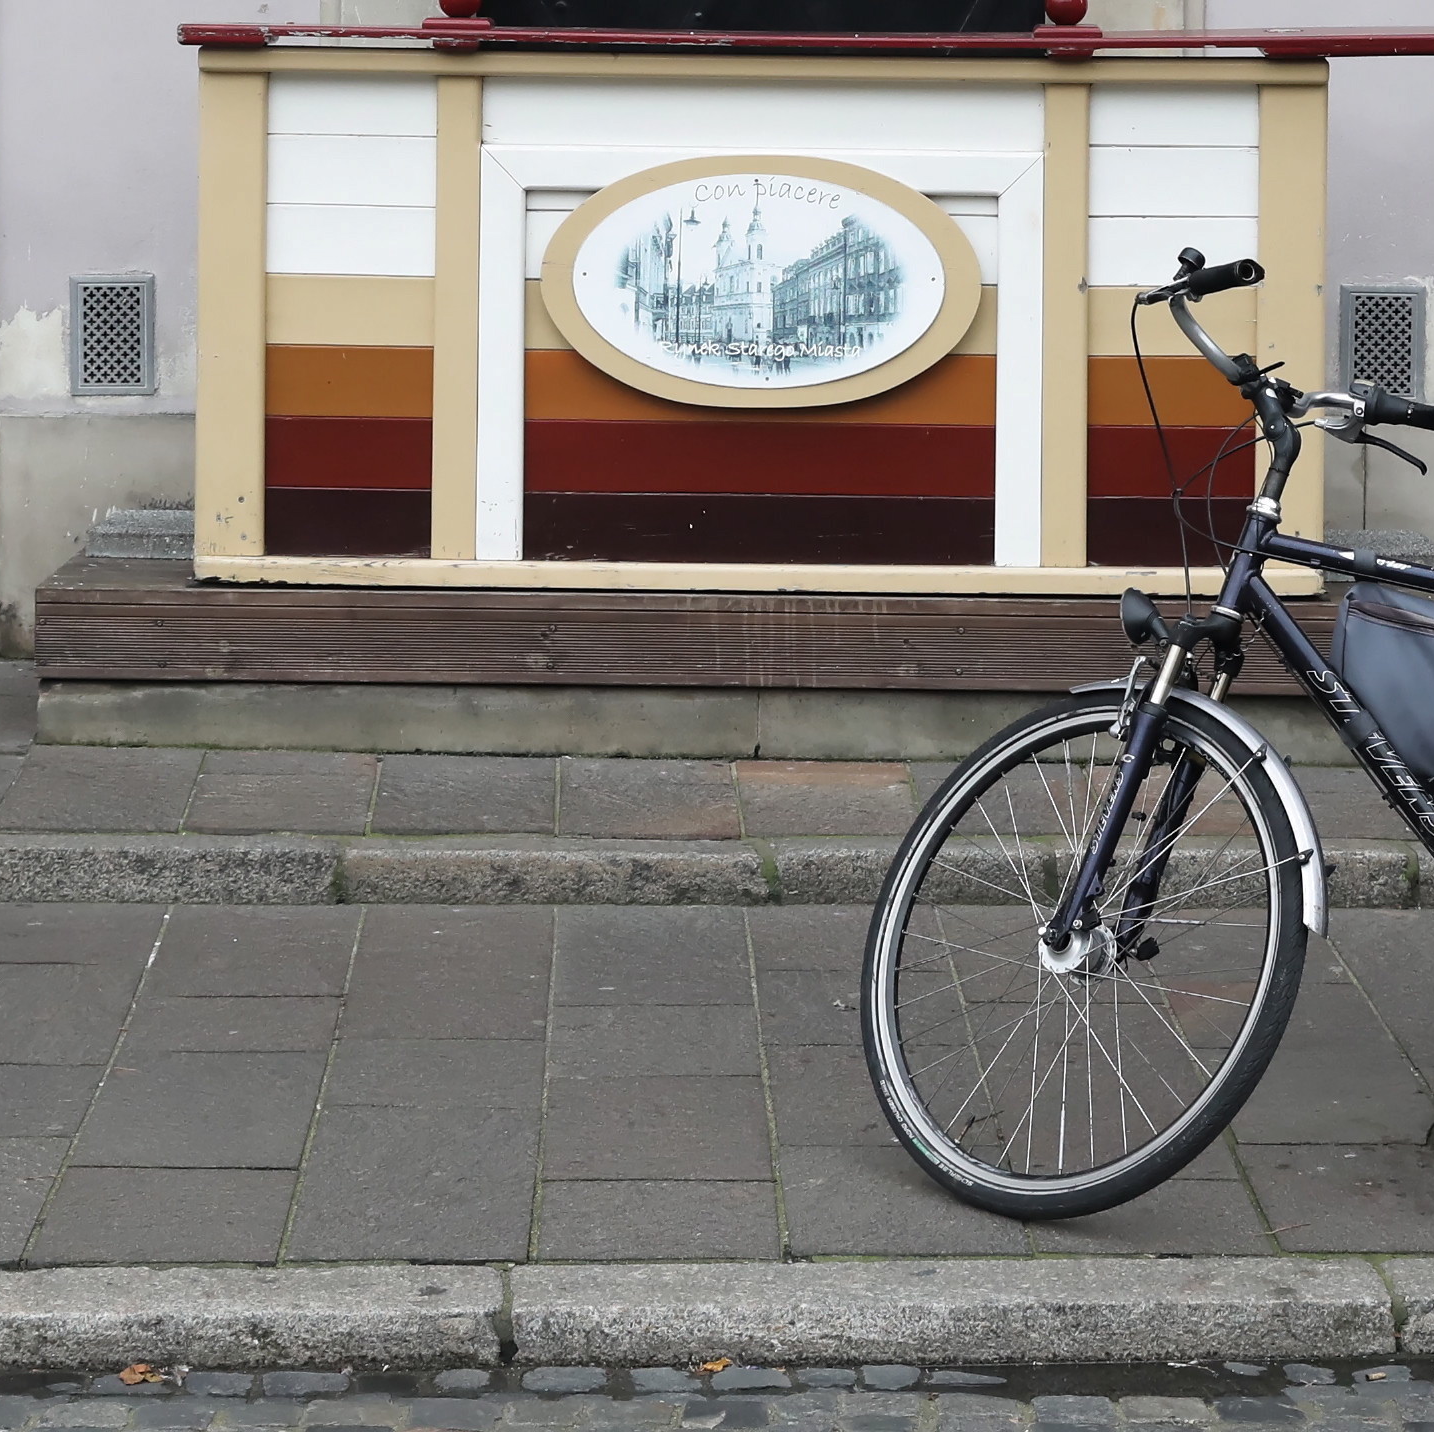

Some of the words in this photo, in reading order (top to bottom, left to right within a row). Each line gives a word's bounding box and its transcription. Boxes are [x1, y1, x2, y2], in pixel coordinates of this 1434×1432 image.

[659, 339, 721, 359] Rynek
[725, 340, 795, 362] Starego
[800, 341, 861, 358] Miasta
